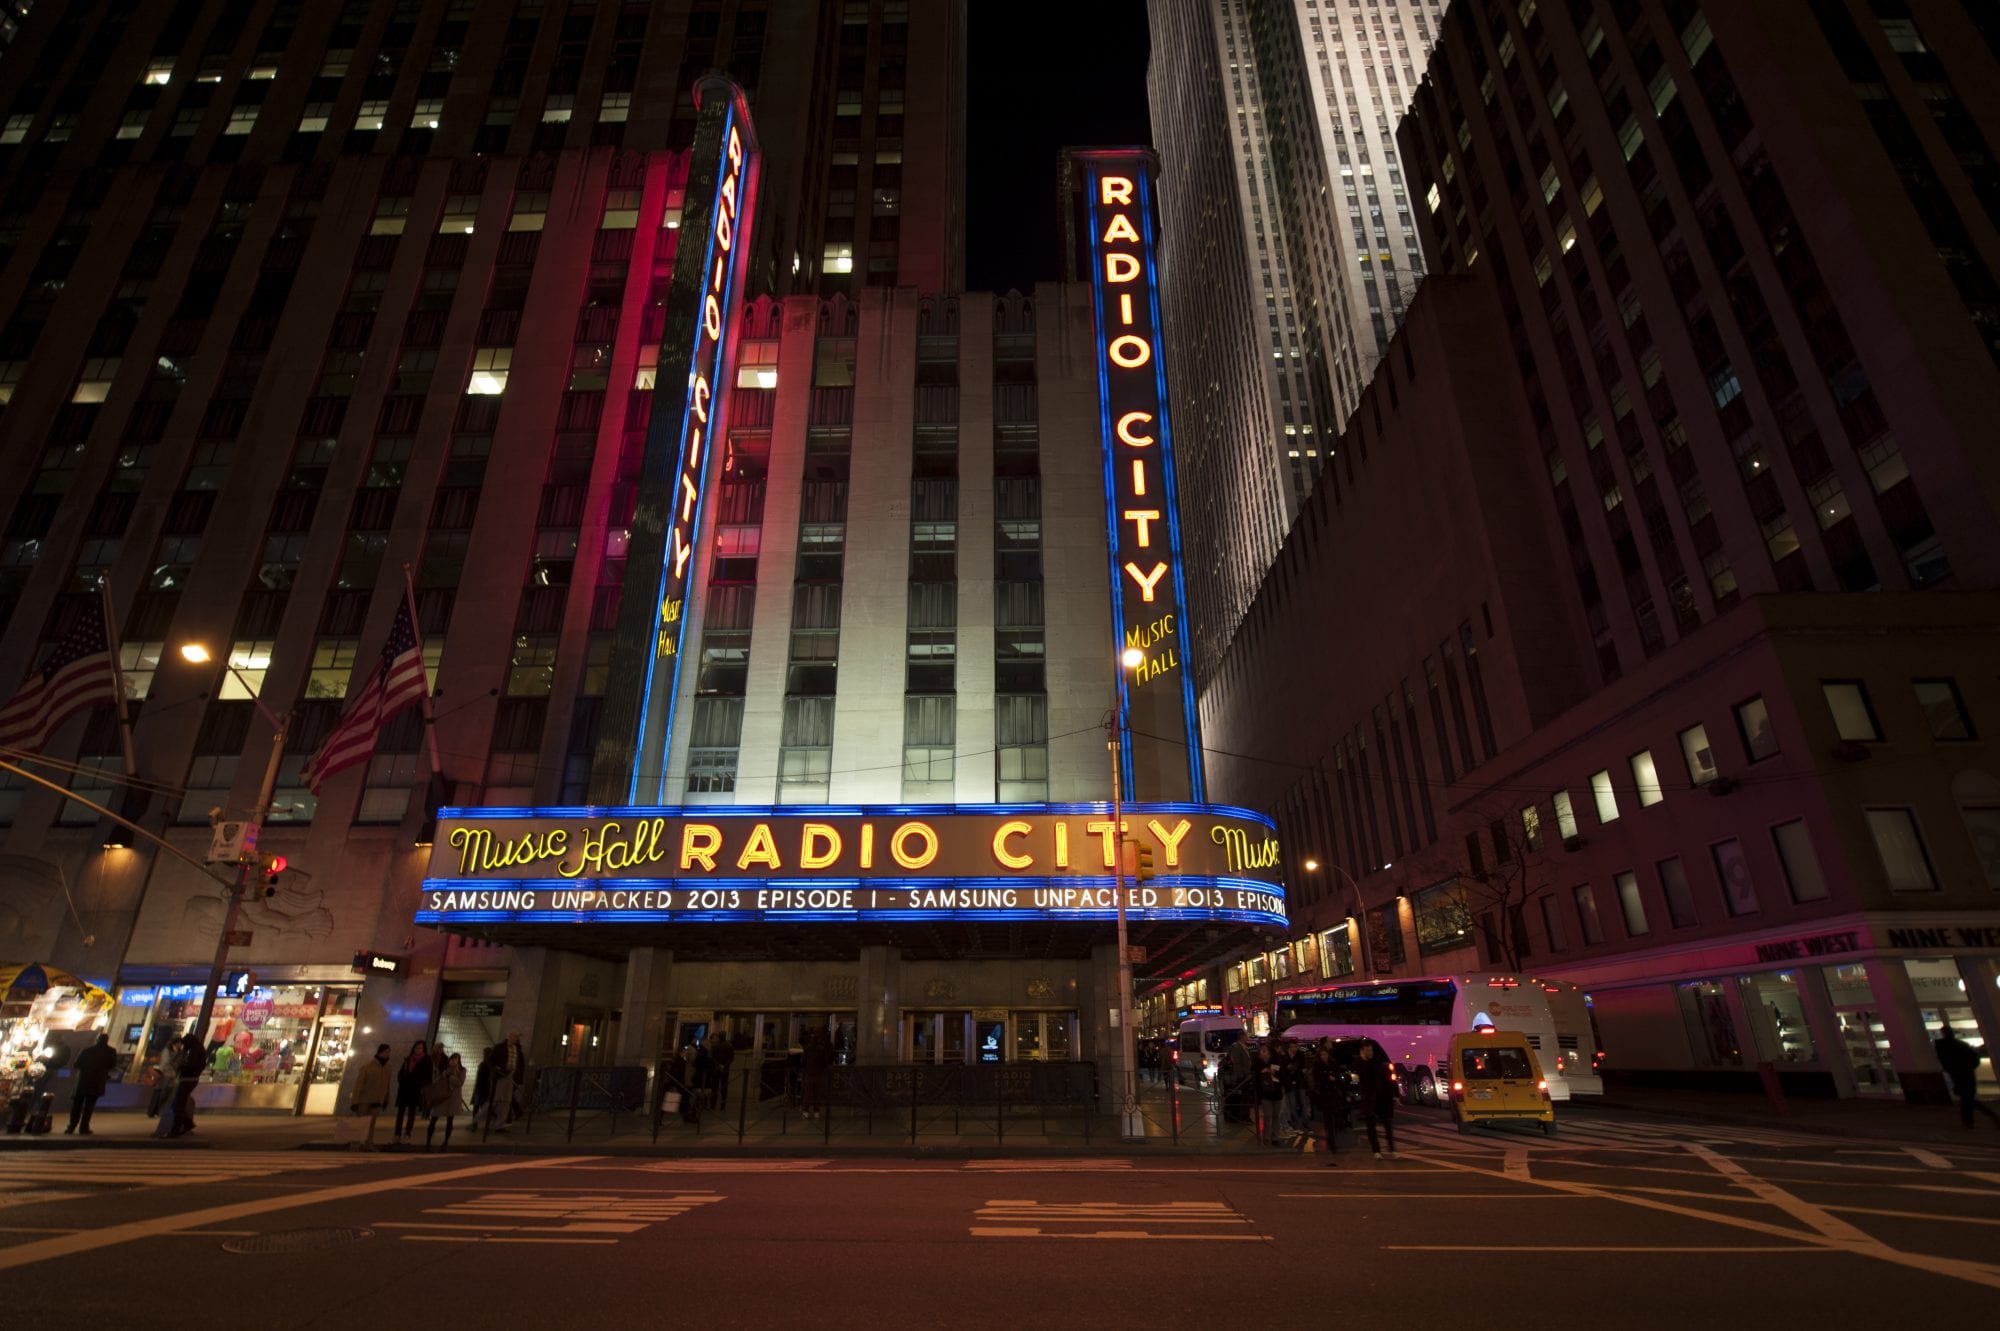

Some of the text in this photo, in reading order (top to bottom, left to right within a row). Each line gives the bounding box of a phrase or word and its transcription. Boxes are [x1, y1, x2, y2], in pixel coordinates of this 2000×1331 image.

[673, 125, 742, 580] RADIO CITY
[1101, 176, 1168, 602] RADIO CITY
[656, 630, 676, 660] HALL
[1126, 614, 1175, 649] MUSIC
[1136, 648, 1178, 687] HALL
[450, 818, 666, 878] Music Hall
[680, 819, 1192, 872] RADIO CITY
[429, 891, 536, 911] SAMSUNG
[551, 890, 672, 910] UNPACKED
[686, 889, 741, 909] 2013
[757, 889, 853, 909] EPISODE
[909, 889, 1017, 909] SAMSUNG
[1174, 890, 1224, 908] 2013
[1755, 932, 1858, 963] NINE WEST
[1888, 928, 2000, 948] NINE WE
